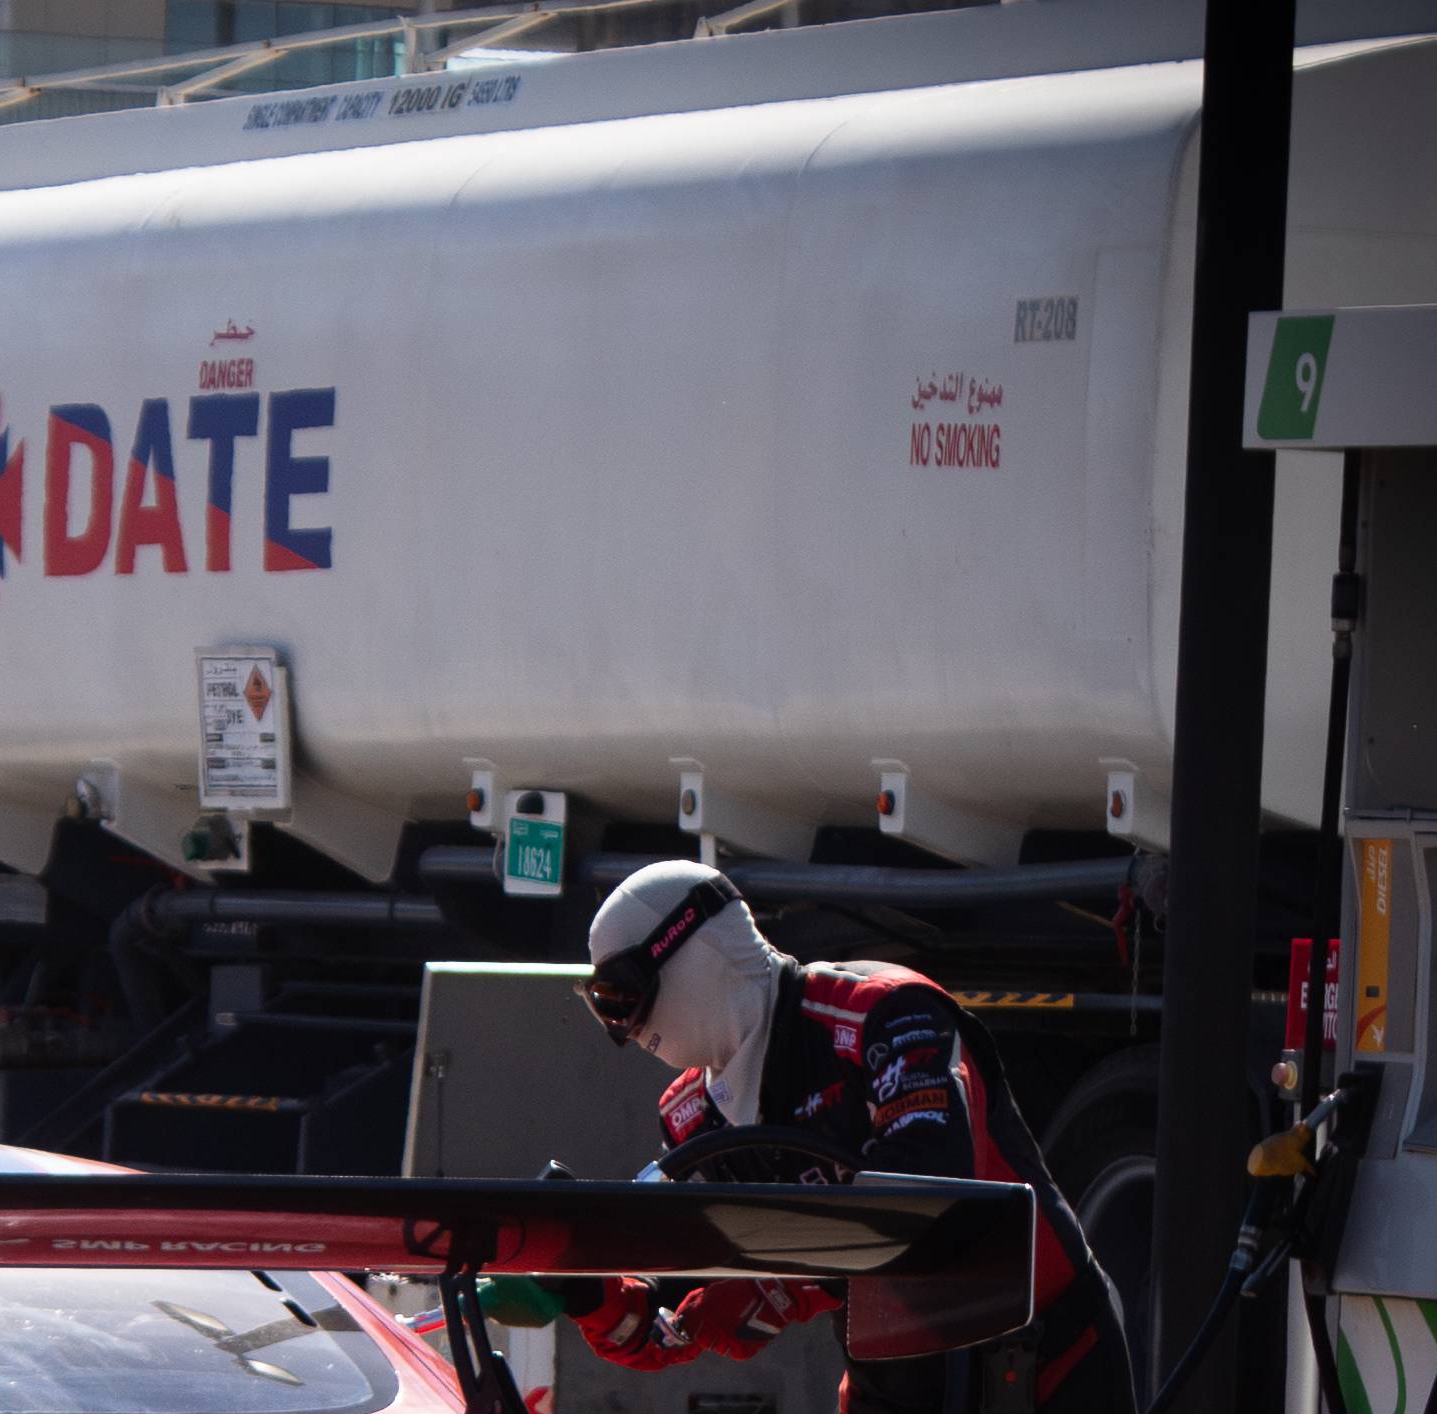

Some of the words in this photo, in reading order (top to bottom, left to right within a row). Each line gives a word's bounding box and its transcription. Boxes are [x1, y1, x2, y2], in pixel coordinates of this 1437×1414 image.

[388, 86, 441, 115] 12000
[199, 358, 255, 390] DANGER
[1296, 351, 1317, 412] 9
[910, 421, 931, 467] NO
[934, 421, 1001, 469] SMOKING
[44, 386, 336, 576] DATE
[1376, 846, 1390, 916] DIESEL
